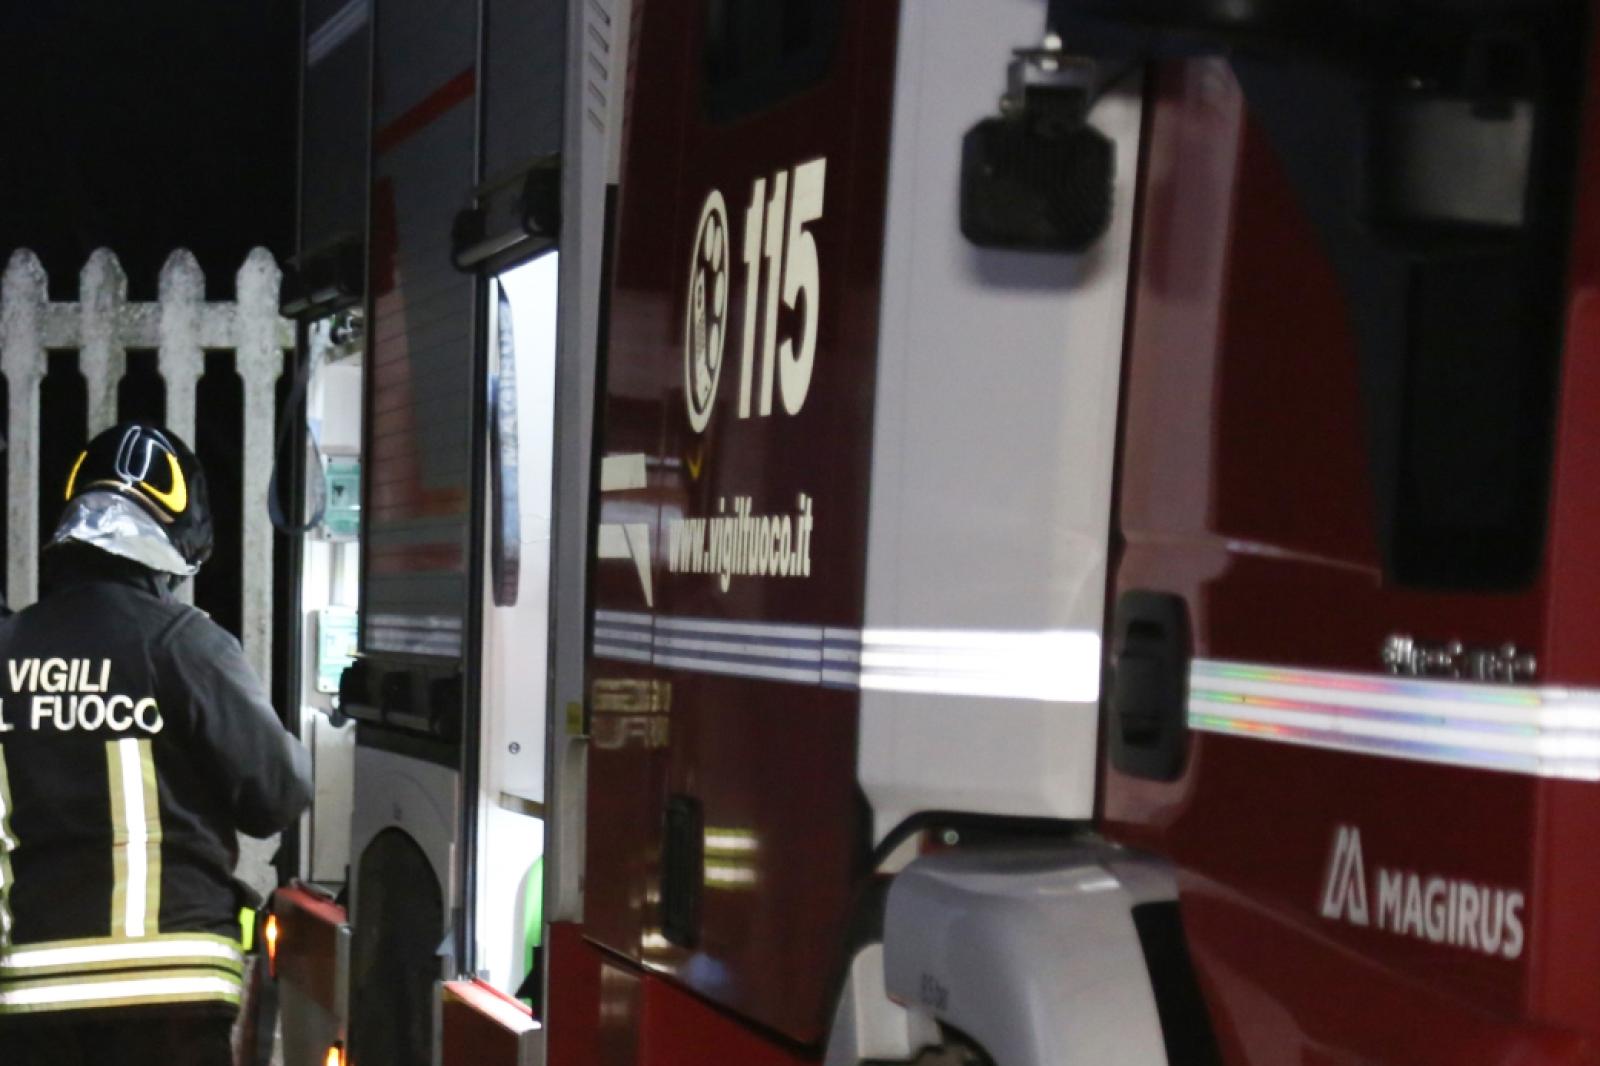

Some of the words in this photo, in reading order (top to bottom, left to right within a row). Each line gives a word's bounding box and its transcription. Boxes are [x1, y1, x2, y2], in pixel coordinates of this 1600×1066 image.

[738, 157, 827, 419] 115
[669, 493, 813, 593] www.vigilfuoco.it
[8, 657, 111, 693] VIGILI
[31, 694, 164, 735] FUOCO
[1377, 868, 1525, 960] MAGIRUS
